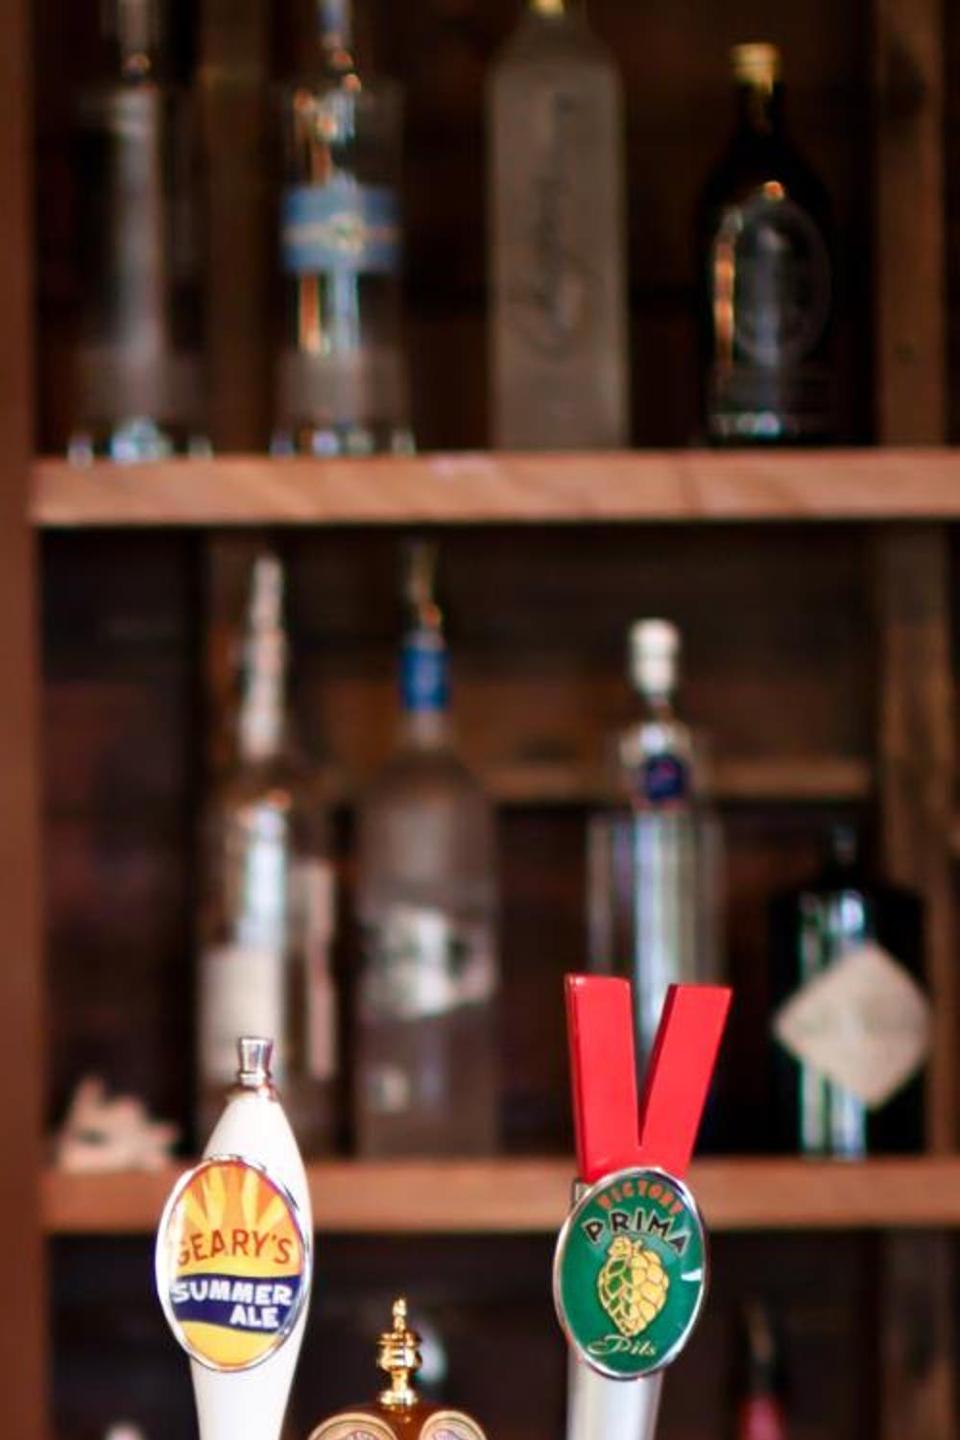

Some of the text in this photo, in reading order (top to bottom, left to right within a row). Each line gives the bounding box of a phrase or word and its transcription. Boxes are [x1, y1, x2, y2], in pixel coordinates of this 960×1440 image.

[583, 1208, 692, 1256] PRIMA
[171, 1280, 292, 1306] SUMMER
[230, 1304, 279, 1328] ALE
[587, 1334, 656, 1356] Pils
